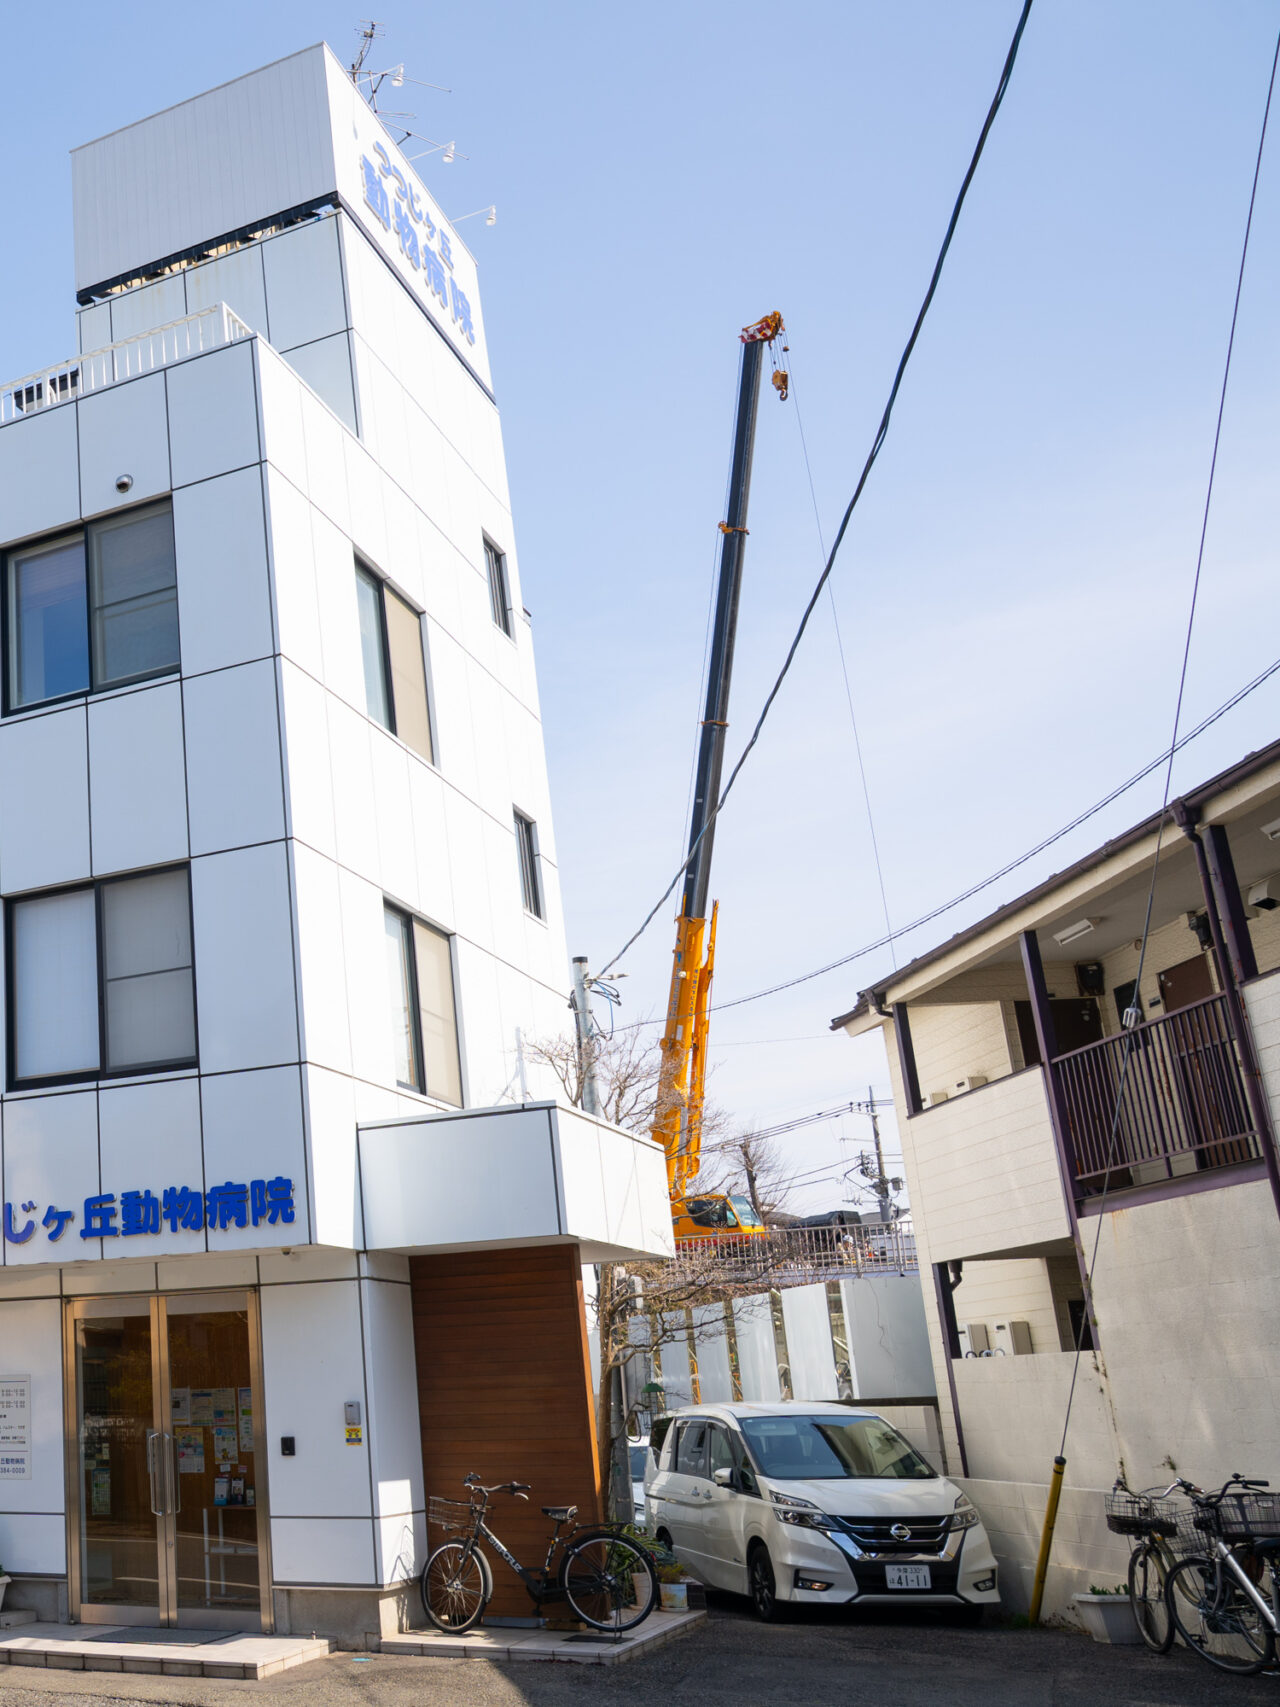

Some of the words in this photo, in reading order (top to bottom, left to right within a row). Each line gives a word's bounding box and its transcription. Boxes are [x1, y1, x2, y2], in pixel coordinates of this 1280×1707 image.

[360, 154, 476, 347] 動物病院
[896, 1574, 927, 1587] 41-11
